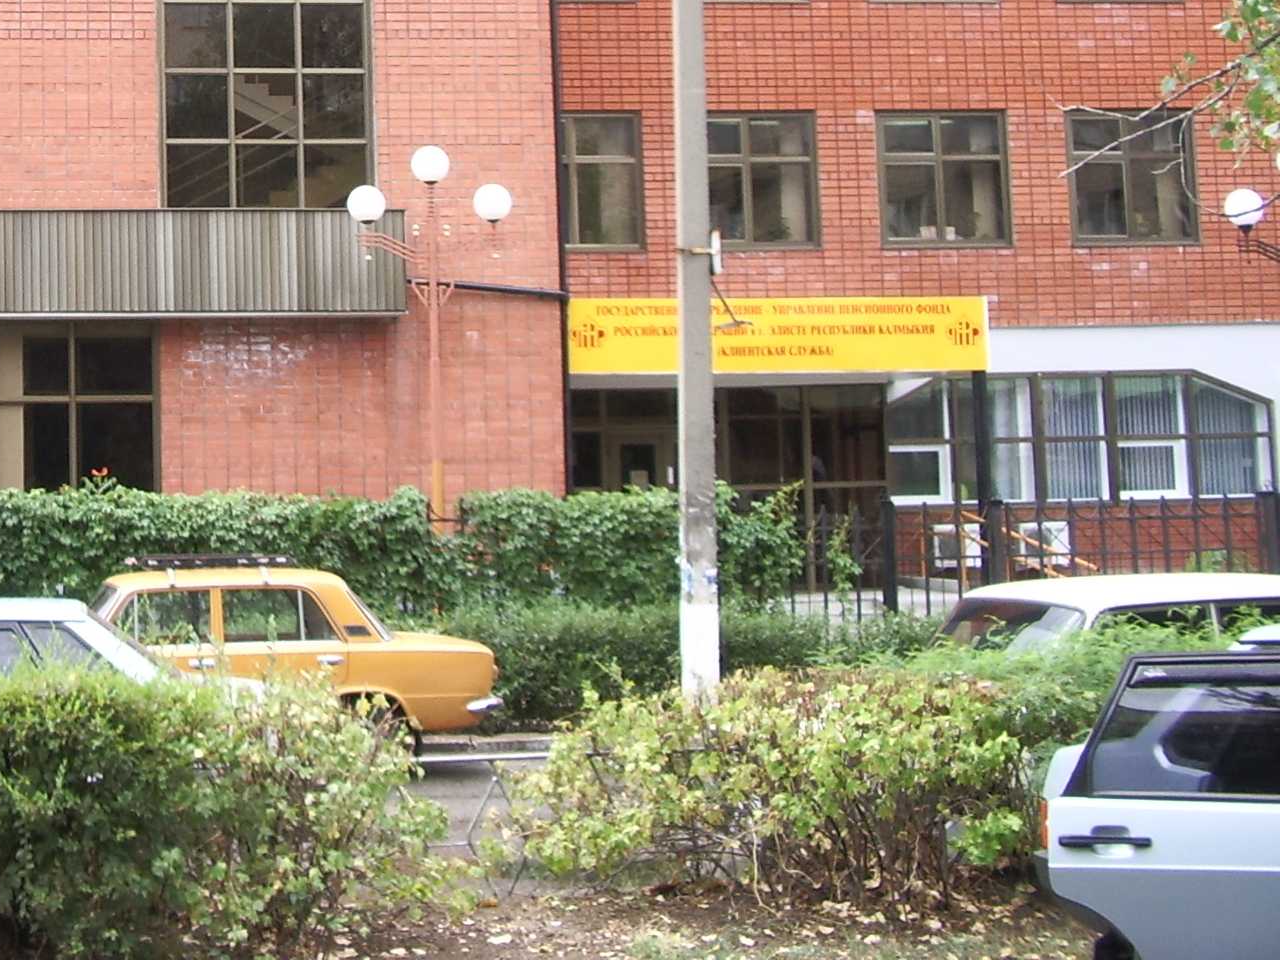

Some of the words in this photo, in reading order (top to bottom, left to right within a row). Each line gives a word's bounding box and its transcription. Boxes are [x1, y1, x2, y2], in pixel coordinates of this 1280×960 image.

[772, 304, 835, 315] УПРАВЛЕНИЕ
[839, 304, 913, 315] ПЕНСИОННОГО
[915, 303, 952, 314] ФОНДА
[613, 325, 677, 336] РОССИЙСКО
[770, 325, 806, 336] ЭЛИСТЕ
[811, 325, 875, 336] РЕСПУБЛИКИ
[878, 324, 935, 336] КАЛМЫКИЯ
